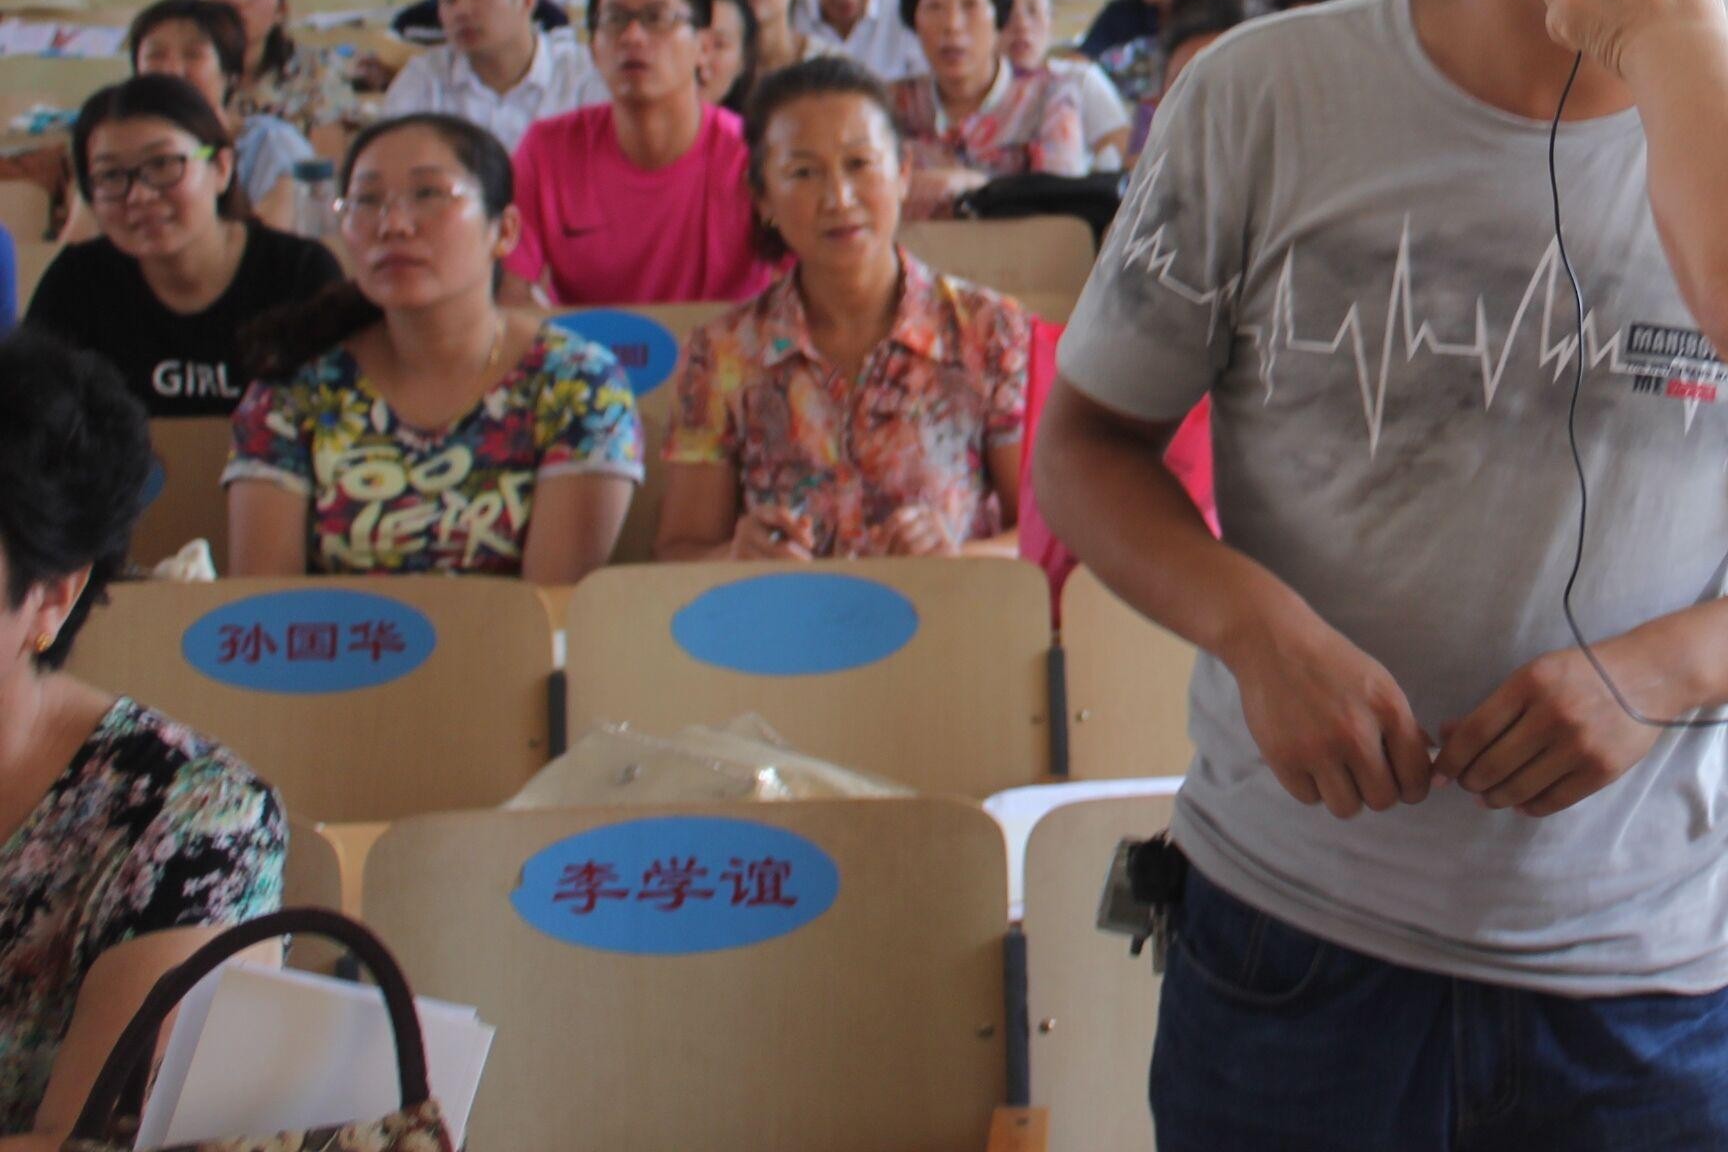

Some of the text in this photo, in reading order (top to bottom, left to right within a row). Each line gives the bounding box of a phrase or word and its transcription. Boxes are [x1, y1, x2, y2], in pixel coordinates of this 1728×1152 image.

[152, 359, 241, 398] GIRL
[217, 620, 407, 665] 孙国华
[552, 855, 799, 915] 李学谊
